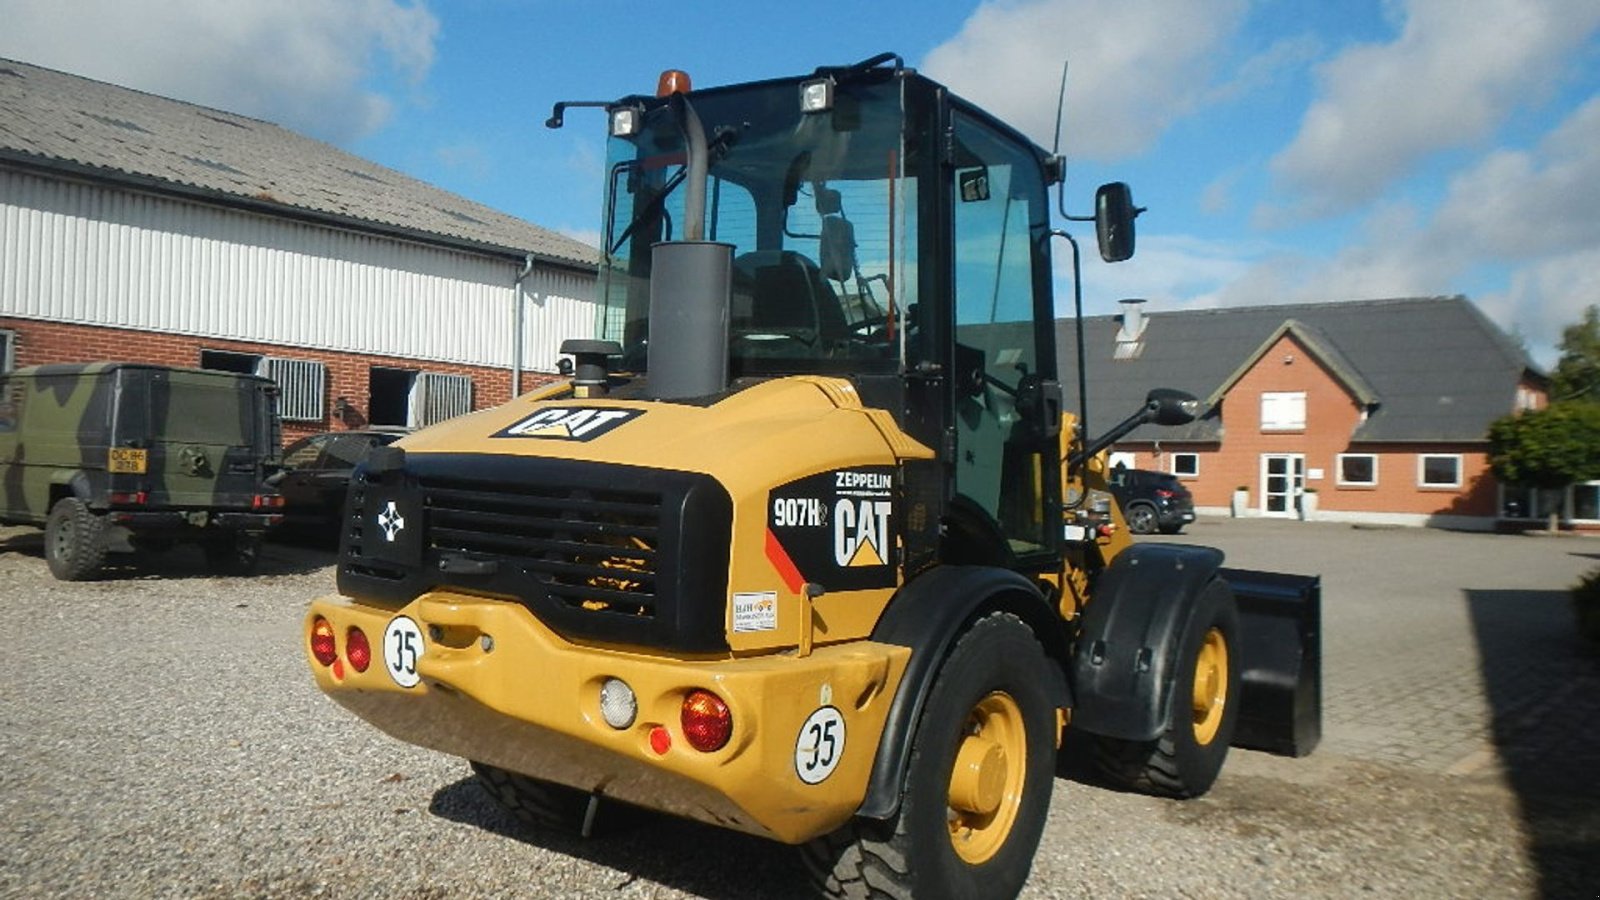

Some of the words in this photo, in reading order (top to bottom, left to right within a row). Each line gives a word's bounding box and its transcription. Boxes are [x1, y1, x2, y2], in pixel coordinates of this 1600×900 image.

[508, 409, 630, 437] CAT
[836, 472, 891, 488] ZEPPELIN
[834, 498, 892, 566] CAT
[393, 629, 416, 675] 35
[806, 719, 837, 770] 35
